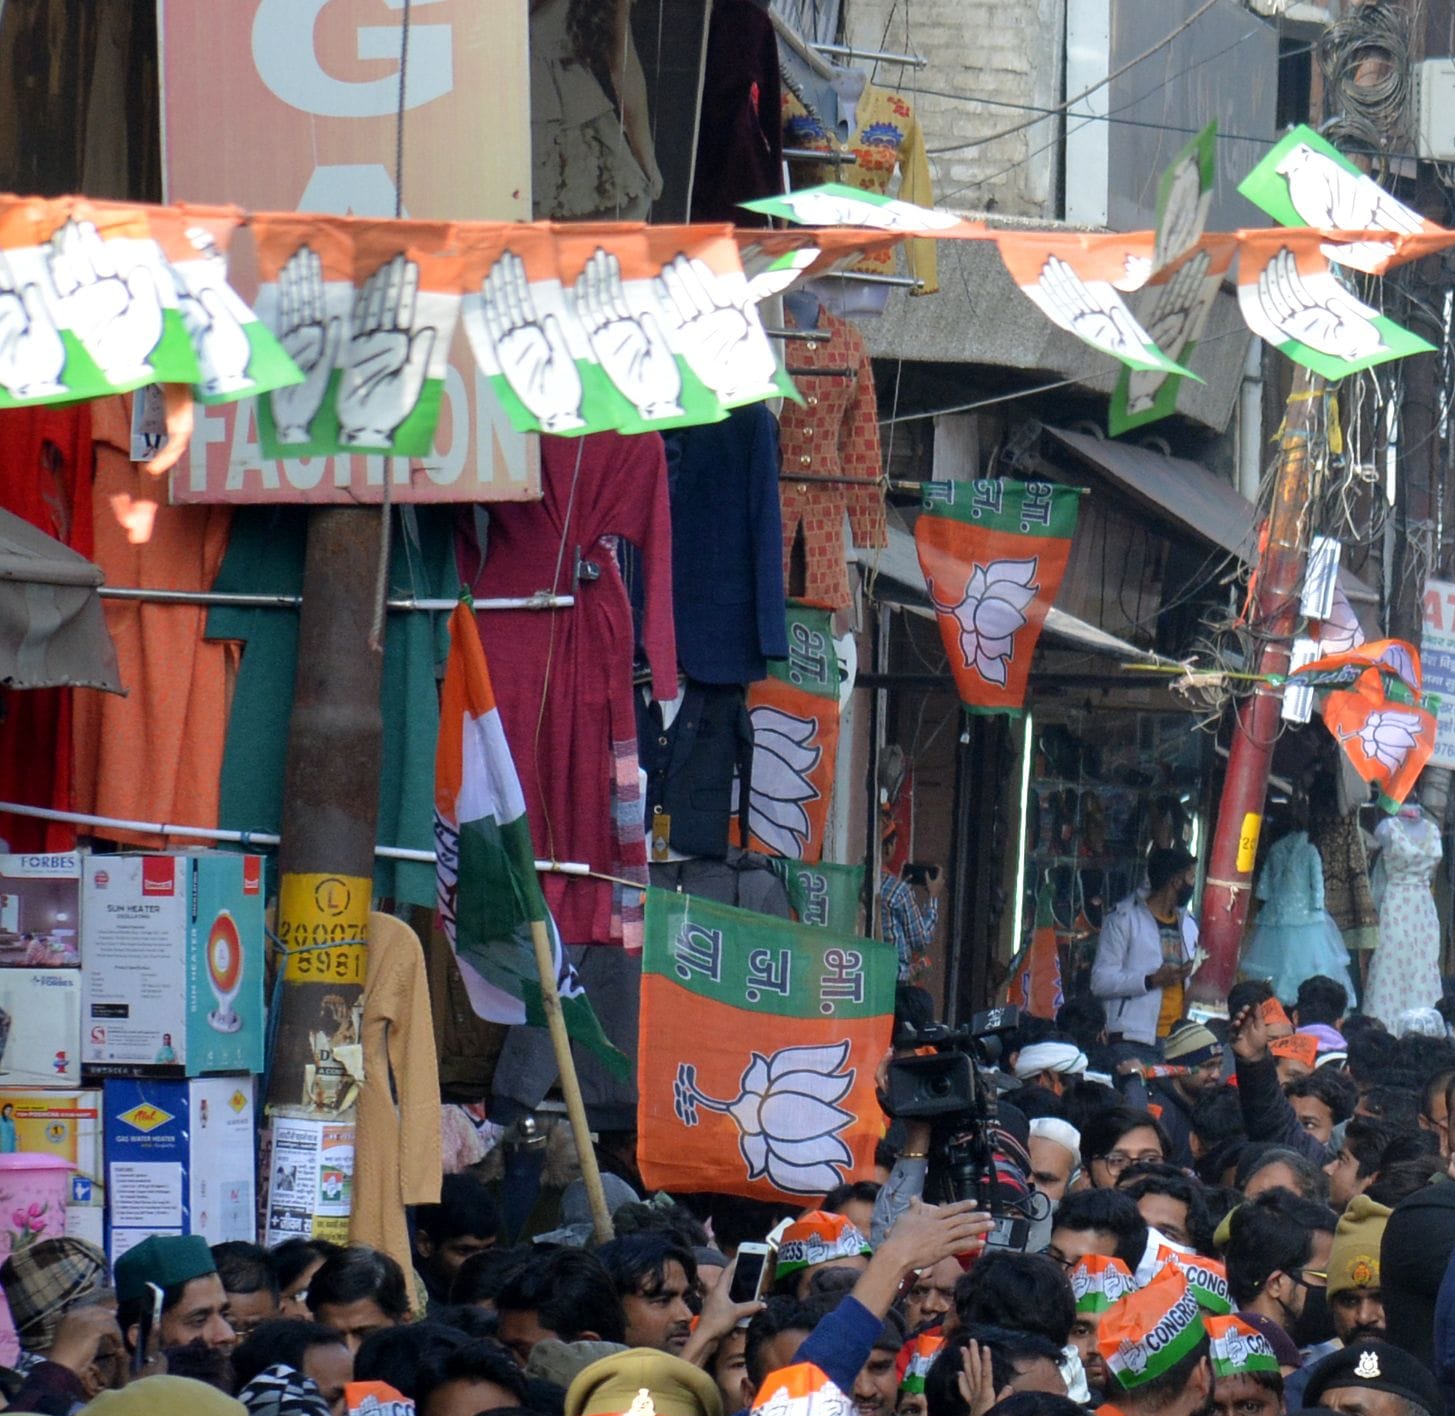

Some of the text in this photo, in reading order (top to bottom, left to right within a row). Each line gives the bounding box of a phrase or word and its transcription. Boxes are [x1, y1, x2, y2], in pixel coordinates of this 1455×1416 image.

[190, 363, 528, 491] FAON
[20, 855, 75, 869] FORBES
[107, 904, 161, 914] SUN HEATER
